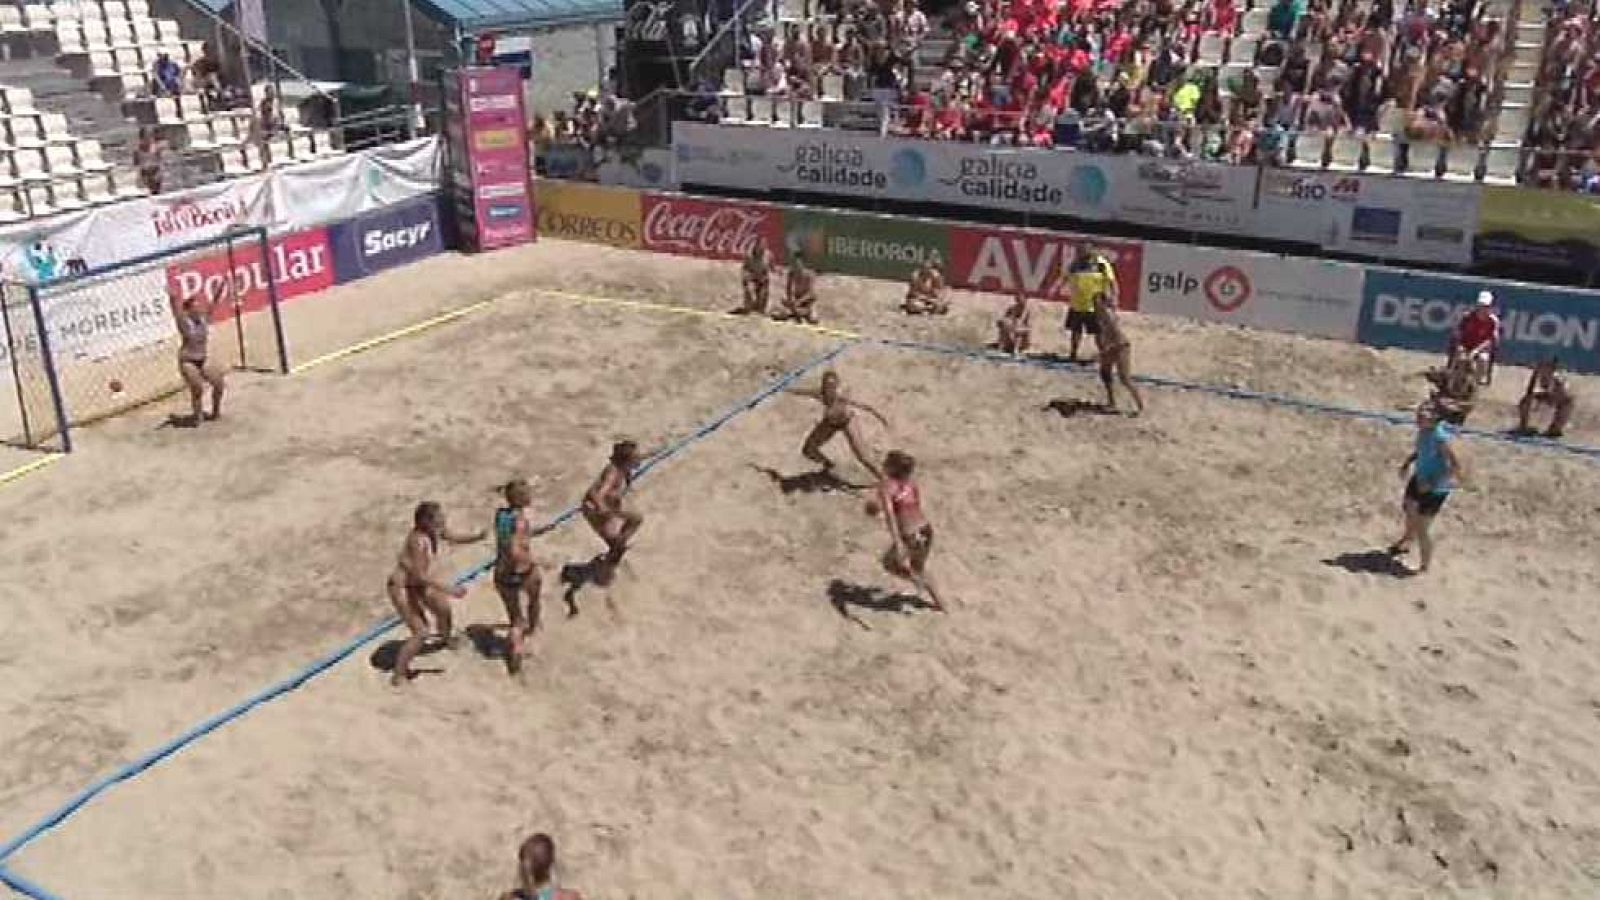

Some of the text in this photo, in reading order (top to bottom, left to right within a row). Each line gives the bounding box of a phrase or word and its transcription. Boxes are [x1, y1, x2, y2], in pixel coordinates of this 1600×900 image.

[797, 165, 886, 189] calidade
[942, 154, 1037, 182] galicia
[961, 179, 1063, 204] calidade
[363, 220, 432, 256] Sacyr
[828, 236, 942, 264] IBERDROLA
[966, 237, 1118, 298] AVI
[1148, 270, 1199, 295] galp
[60, 298, 164, 340] MORENAS
